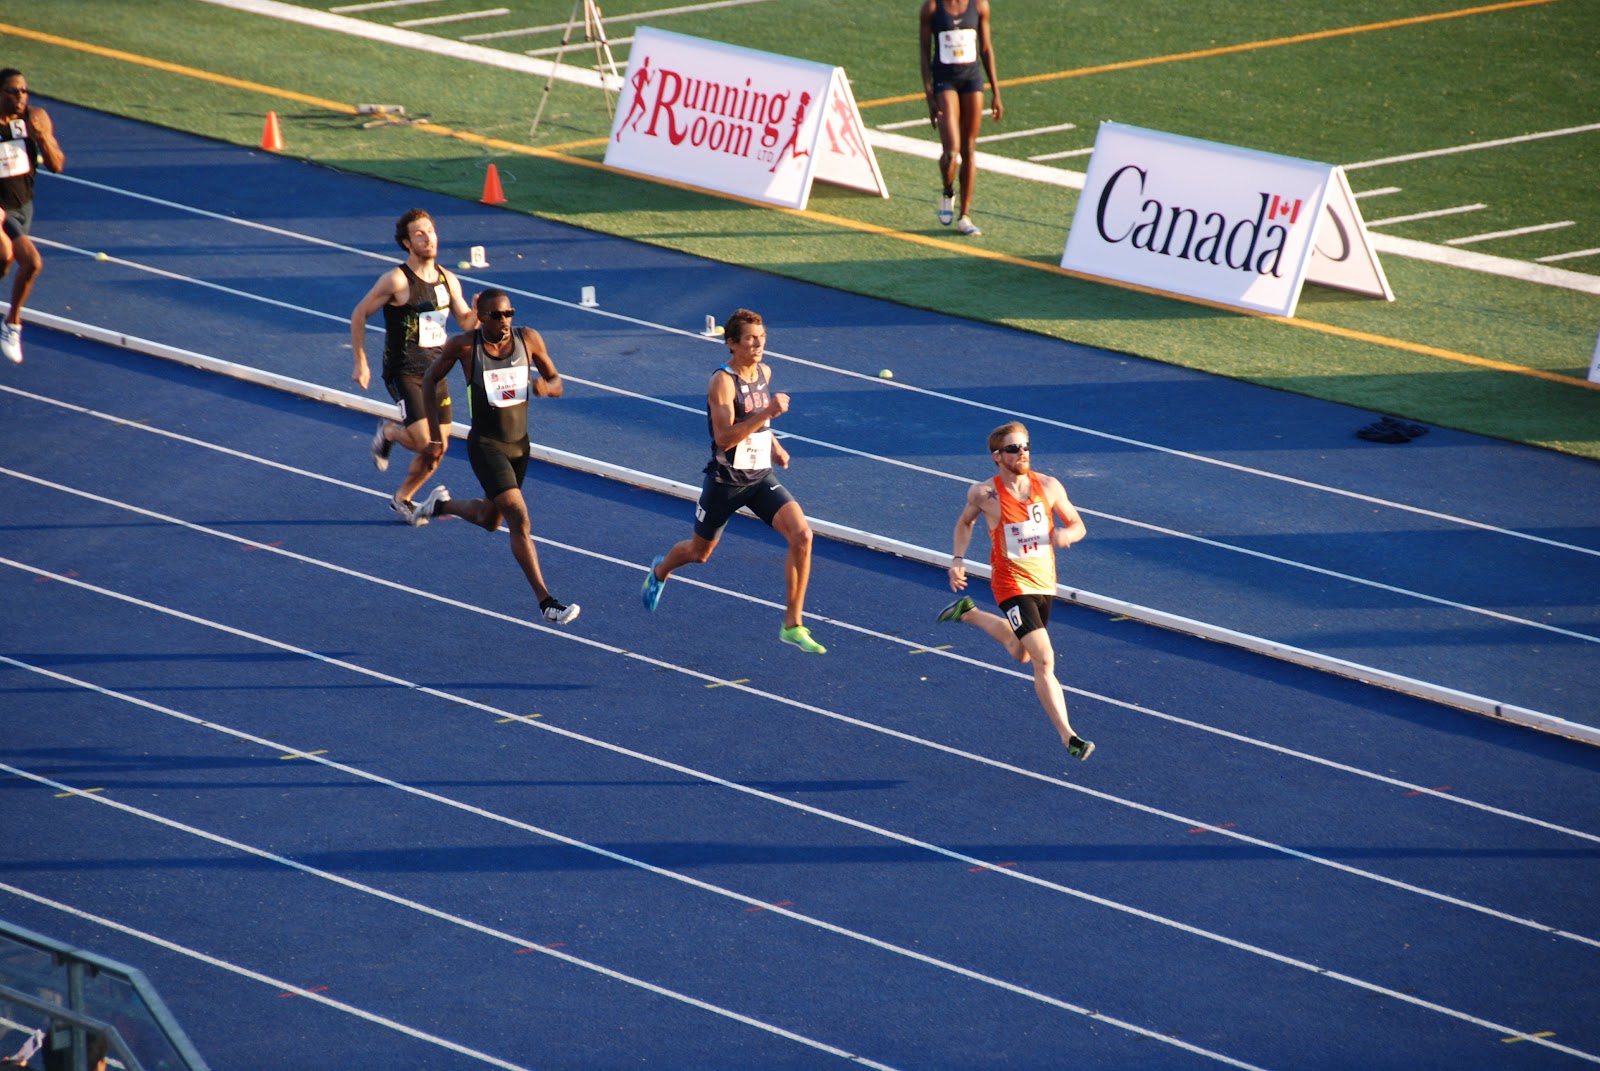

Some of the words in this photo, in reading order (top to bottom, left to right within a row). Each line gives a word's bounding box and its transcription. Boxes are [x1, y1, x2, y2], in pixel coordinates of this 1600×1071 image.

[644, 68, 790, 148] Running
[14, 122, 23, 137] 5
[1096, 165, 1288, 278] Canada
[1032, 505, 1042, 524] 6
[1010, 609, 1019, 627] 6
